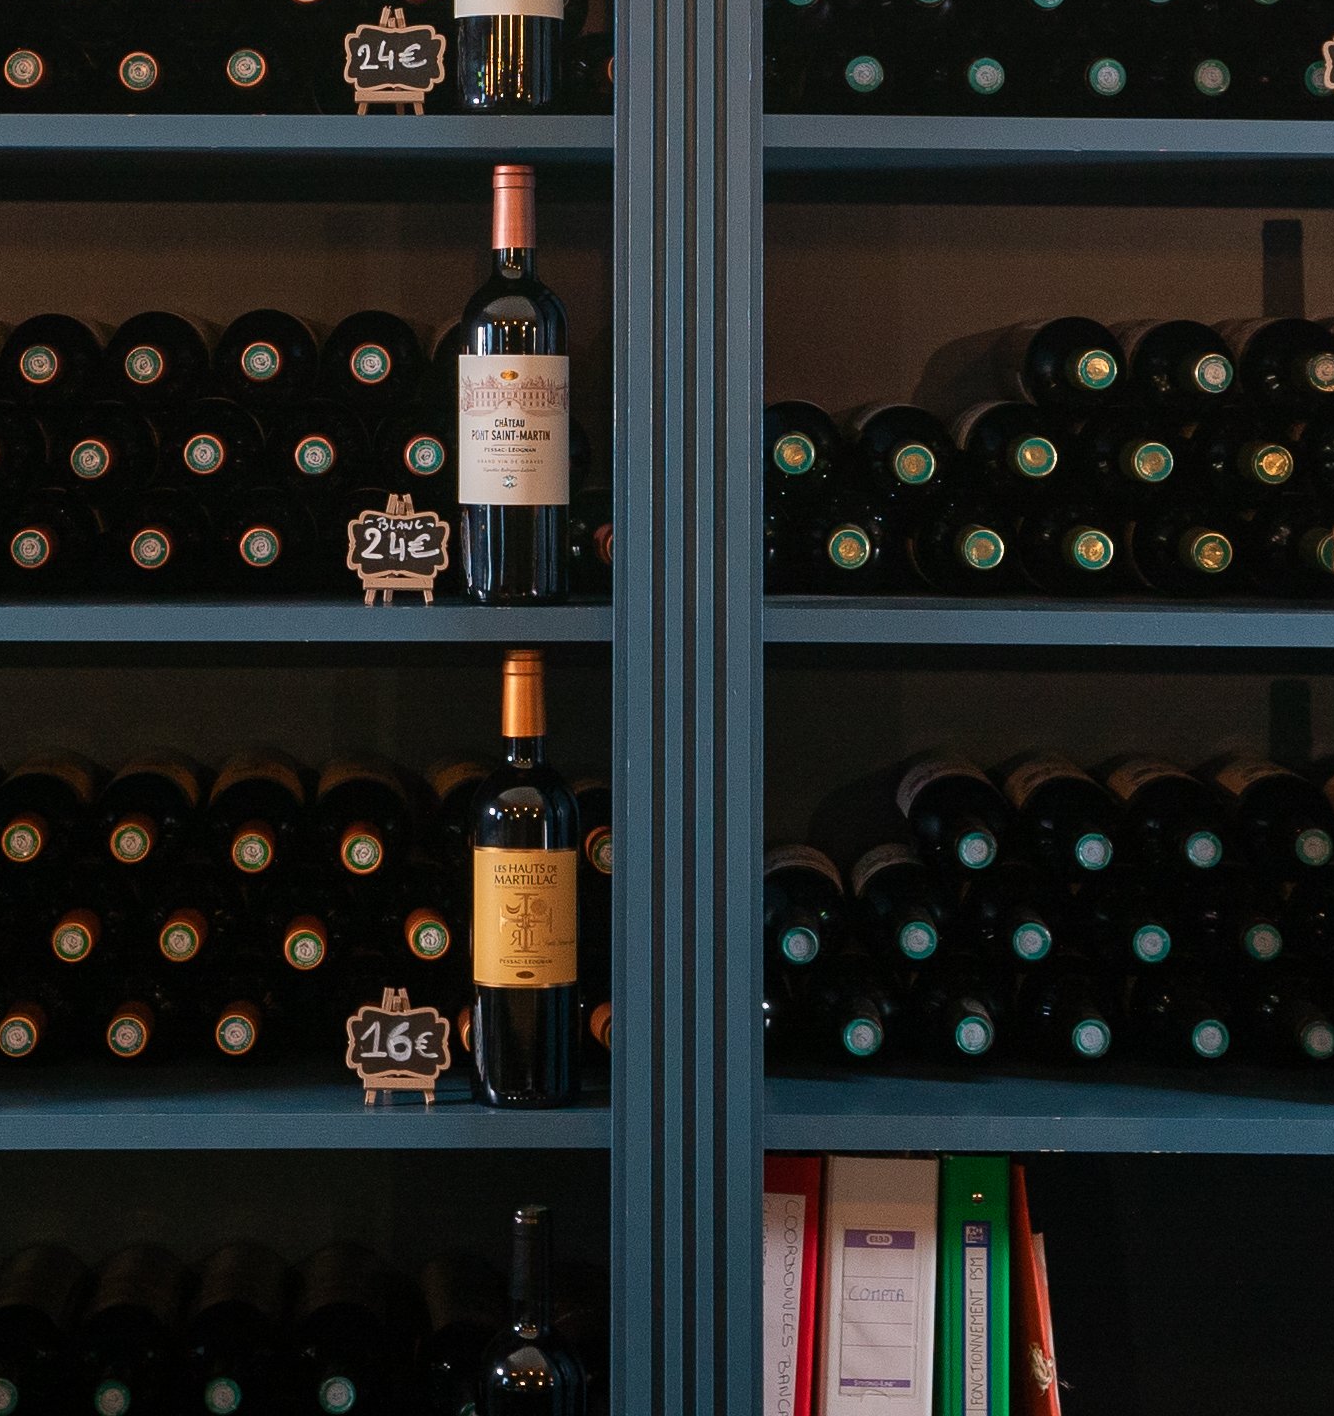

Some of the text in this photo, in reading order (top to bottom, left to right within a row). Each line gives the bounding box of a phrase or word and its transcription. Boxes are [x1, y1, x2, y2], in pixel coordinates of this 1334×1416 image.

[356, 40, 428, 71] 24€
[494, 417, 526, 428] CHÂTEAU
[471, 430, 551, 441] PONT SAINT-MARTIN
[376, 517, 424, 531] BLANC
[360, 528, 441, 563] 24€
[494, 864, 507, 873] LES
[508, 863, 546, 873] HAUTS
[494, 874, 559, 885] MARTILLAC
[359, 1020, 441, 1062] 16€
[849, 1285, 905, 1302] COMPTA
[969, 1255, 985, 1407] FONCTIONNEMENT PSM
